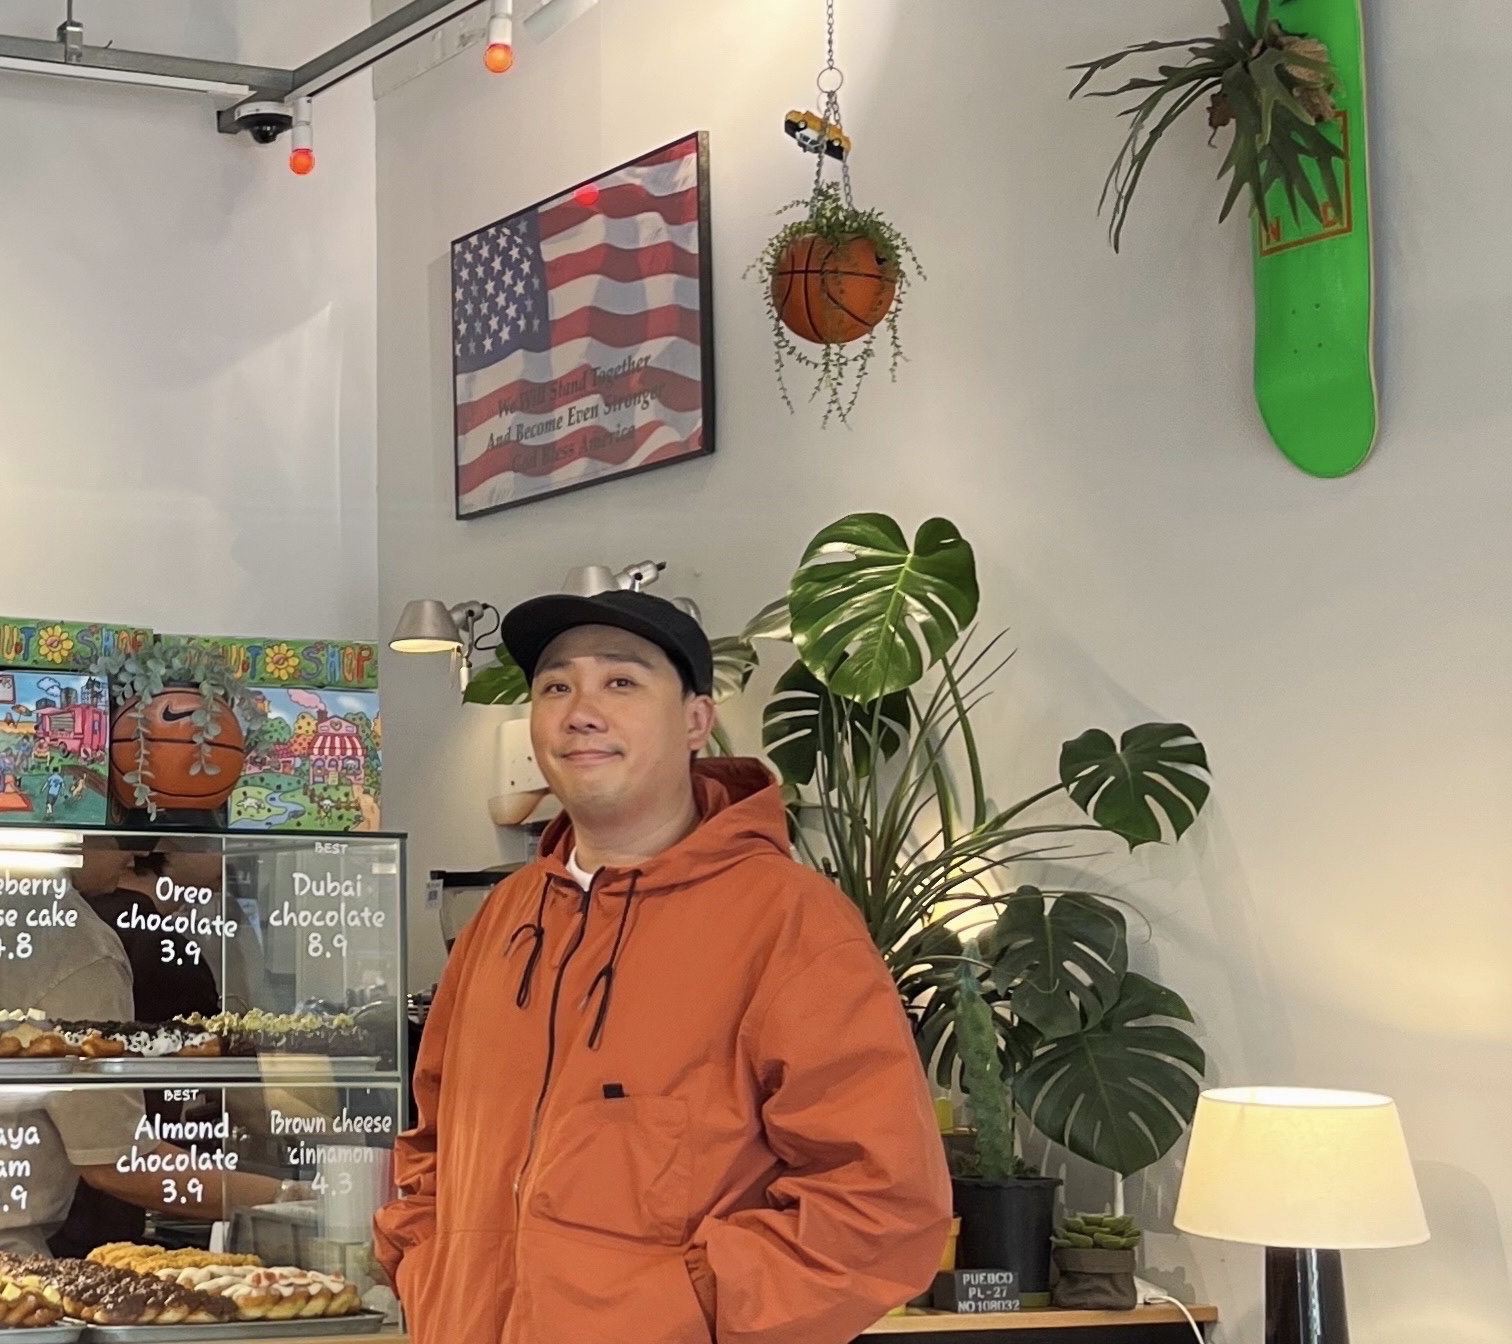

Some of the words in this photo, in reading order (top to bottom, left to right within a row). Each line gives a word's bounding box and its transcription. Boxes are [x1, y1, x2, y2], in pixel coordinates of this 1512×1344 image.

[550, 375, 587, 400] Stand
[592, 354, 651, 386] Together
[488, 427, 511, 451] And
[516, 414, 563, 443] Become
[567, 403, 599, 426] Even
[603, 383, 665, 418] Stronger
[579, 423, 636, 455] America
[300, 641, 374, 683] SHOP
[315, 842, 349, 854] BEST
[155, 876, 212, 904] Oreo
[292, 872, 362, 897] Dubai
[26, 901, 78, 927] cake
[116, 903, 238, 937] chocolate
[269, 901, 386, 928] chocolate
[160, 939, 201, 966] 3.9
[308, 932, 348, 958] 8.9
[164, 1089, 199, 1101] BEST
[134, 1112, 230, 1140] Almond
[270, 1109, 326, 1134] Brown
[333, 1108, 392, 1132] cheese
[116, 1145, 238, 1173] chocolate
[289, 1141, 374, 1165] cinnamon
[162, 1177, 203, 1204] 3.9
[311, 1172, 353, 1195] 4.3
[962, 1271, 1014, 1285] PUEBCO
